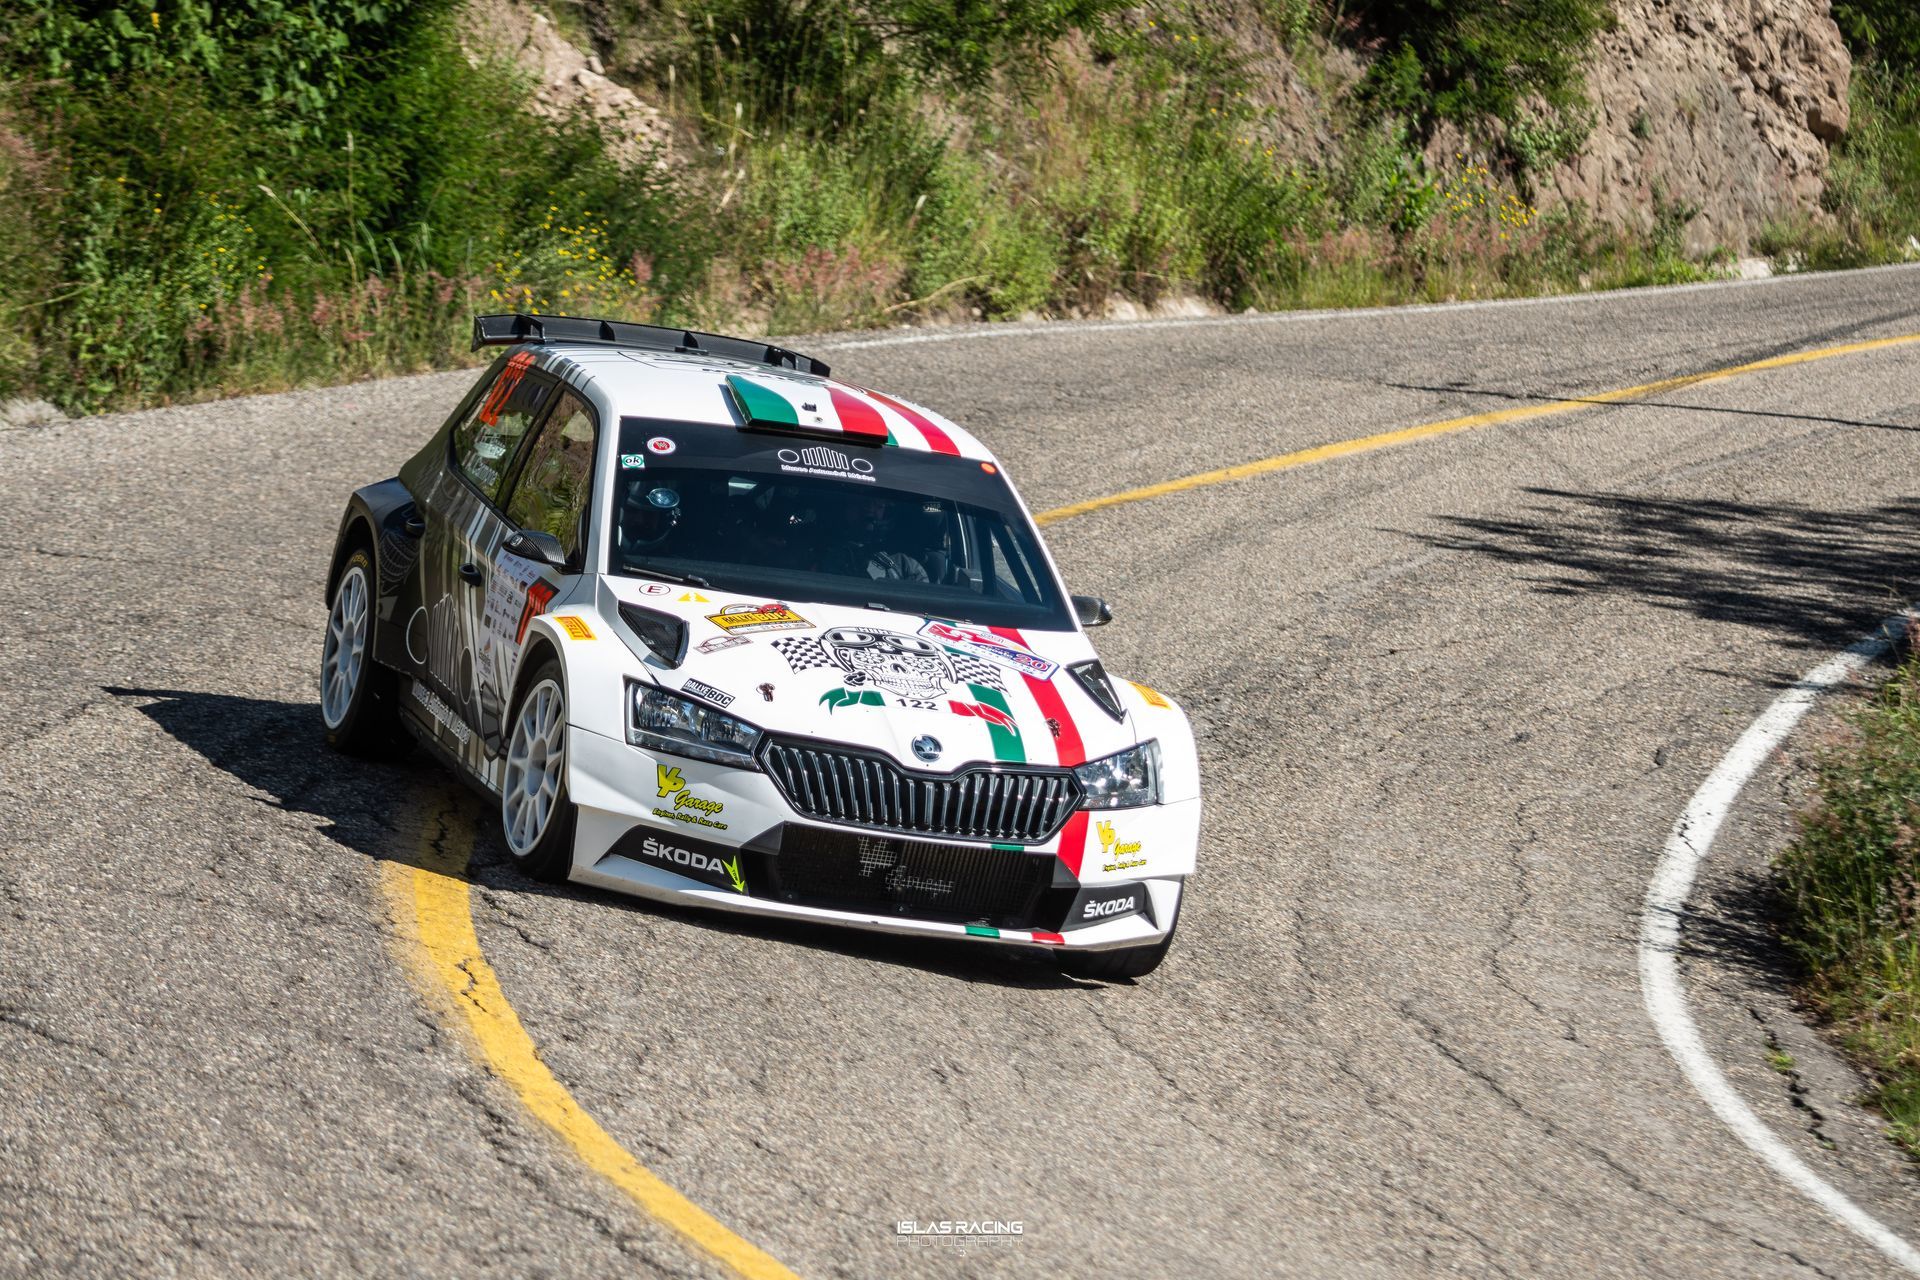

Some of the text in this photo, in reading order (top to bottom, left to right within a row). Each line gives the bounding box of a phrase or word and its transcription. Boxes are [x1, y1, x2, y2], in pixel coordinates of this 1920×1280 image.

[646, 585, 663, 594] E
[1013, 654, 1049, 672] 20
[685, 680, 711, 694] RALLYE
[707, 690, 731, 705] BDC
[896, 698, 939, 711] 122
[674, 789, 724, 817] Garage
[642, 837, 725, 875] ŠKODA
[1113, 838, 1142, 861] Garage
[1083, 896, 1135, 919] ŠKODA
